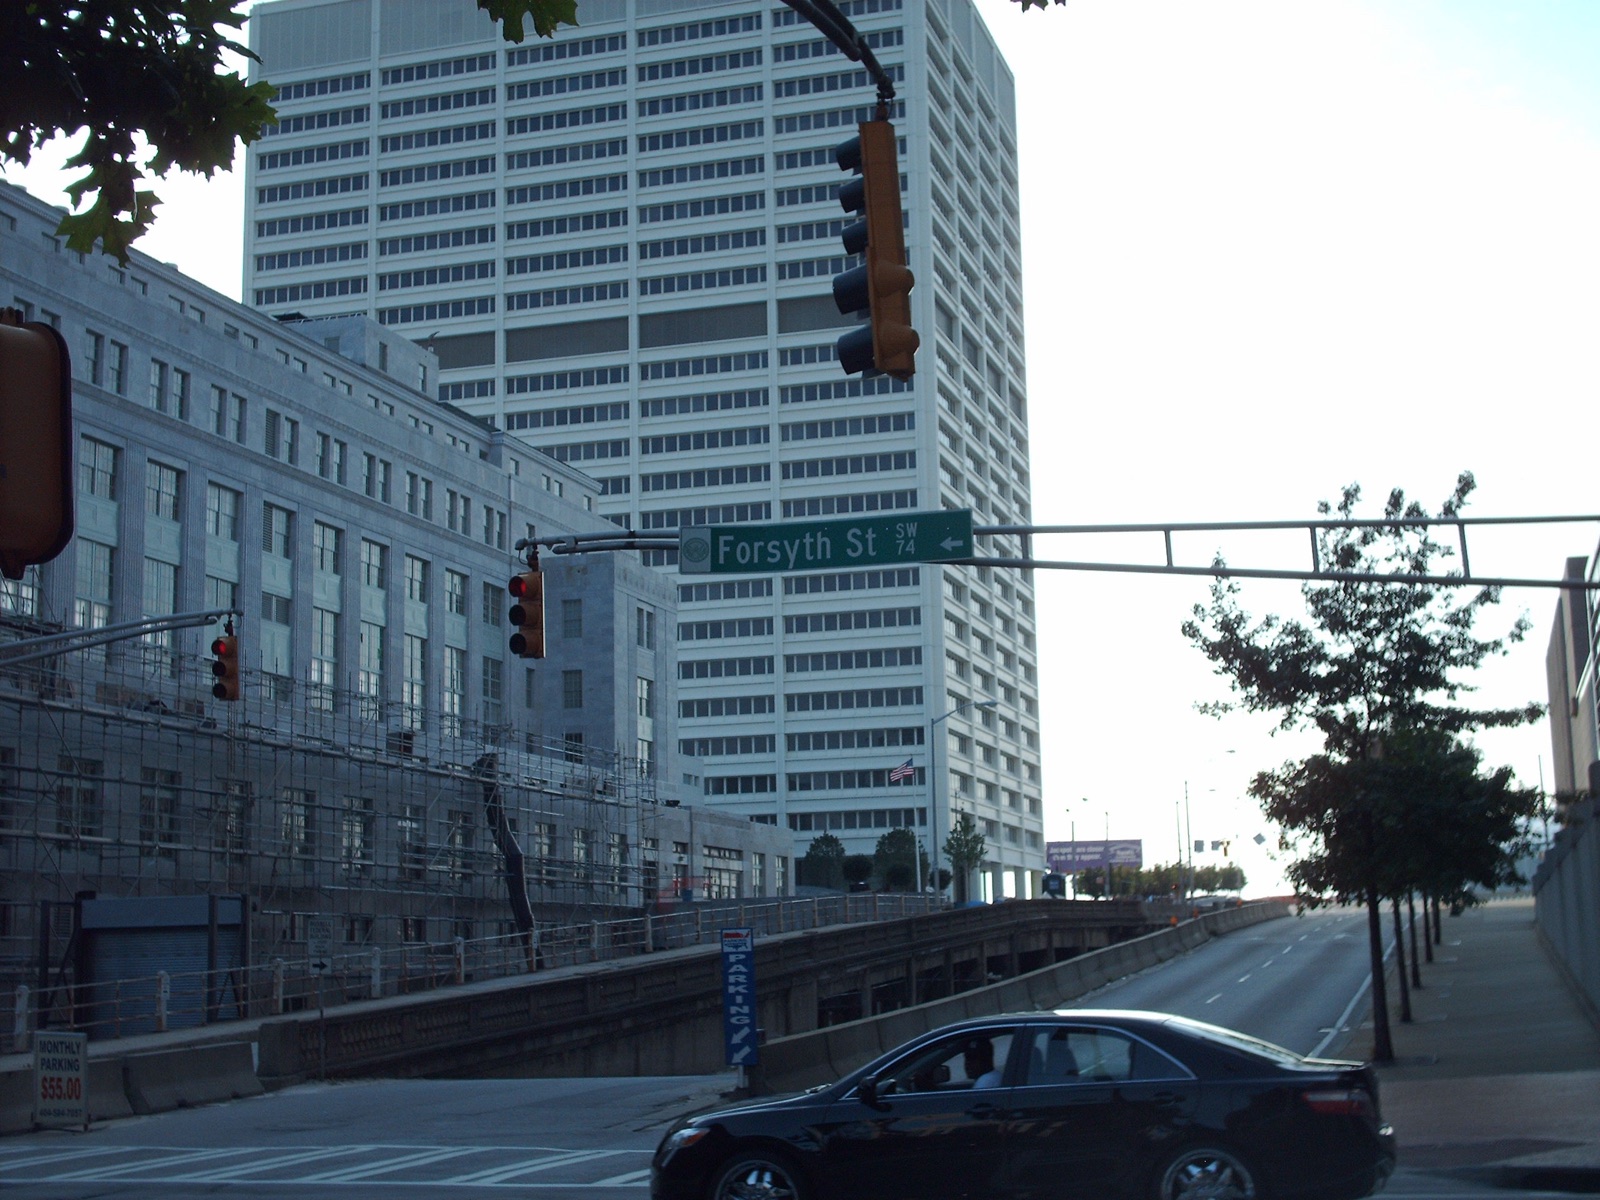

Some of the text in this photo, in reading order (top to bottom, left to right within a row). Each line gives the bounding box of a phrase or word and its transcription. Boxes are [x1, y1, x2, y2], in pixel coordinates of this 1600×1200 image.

[895, 522, 918, 538] SW
[718, 527, 877, 569] Forsyth St
[896, 539, 916, 555] 74
[728, 953, 750, 1024] PARKING
[39, 1040, 81, 1054] MONTHLY
[40, 1058, 80, 1072] PARKING
[41, 1075, 81, 1101] $55.00
